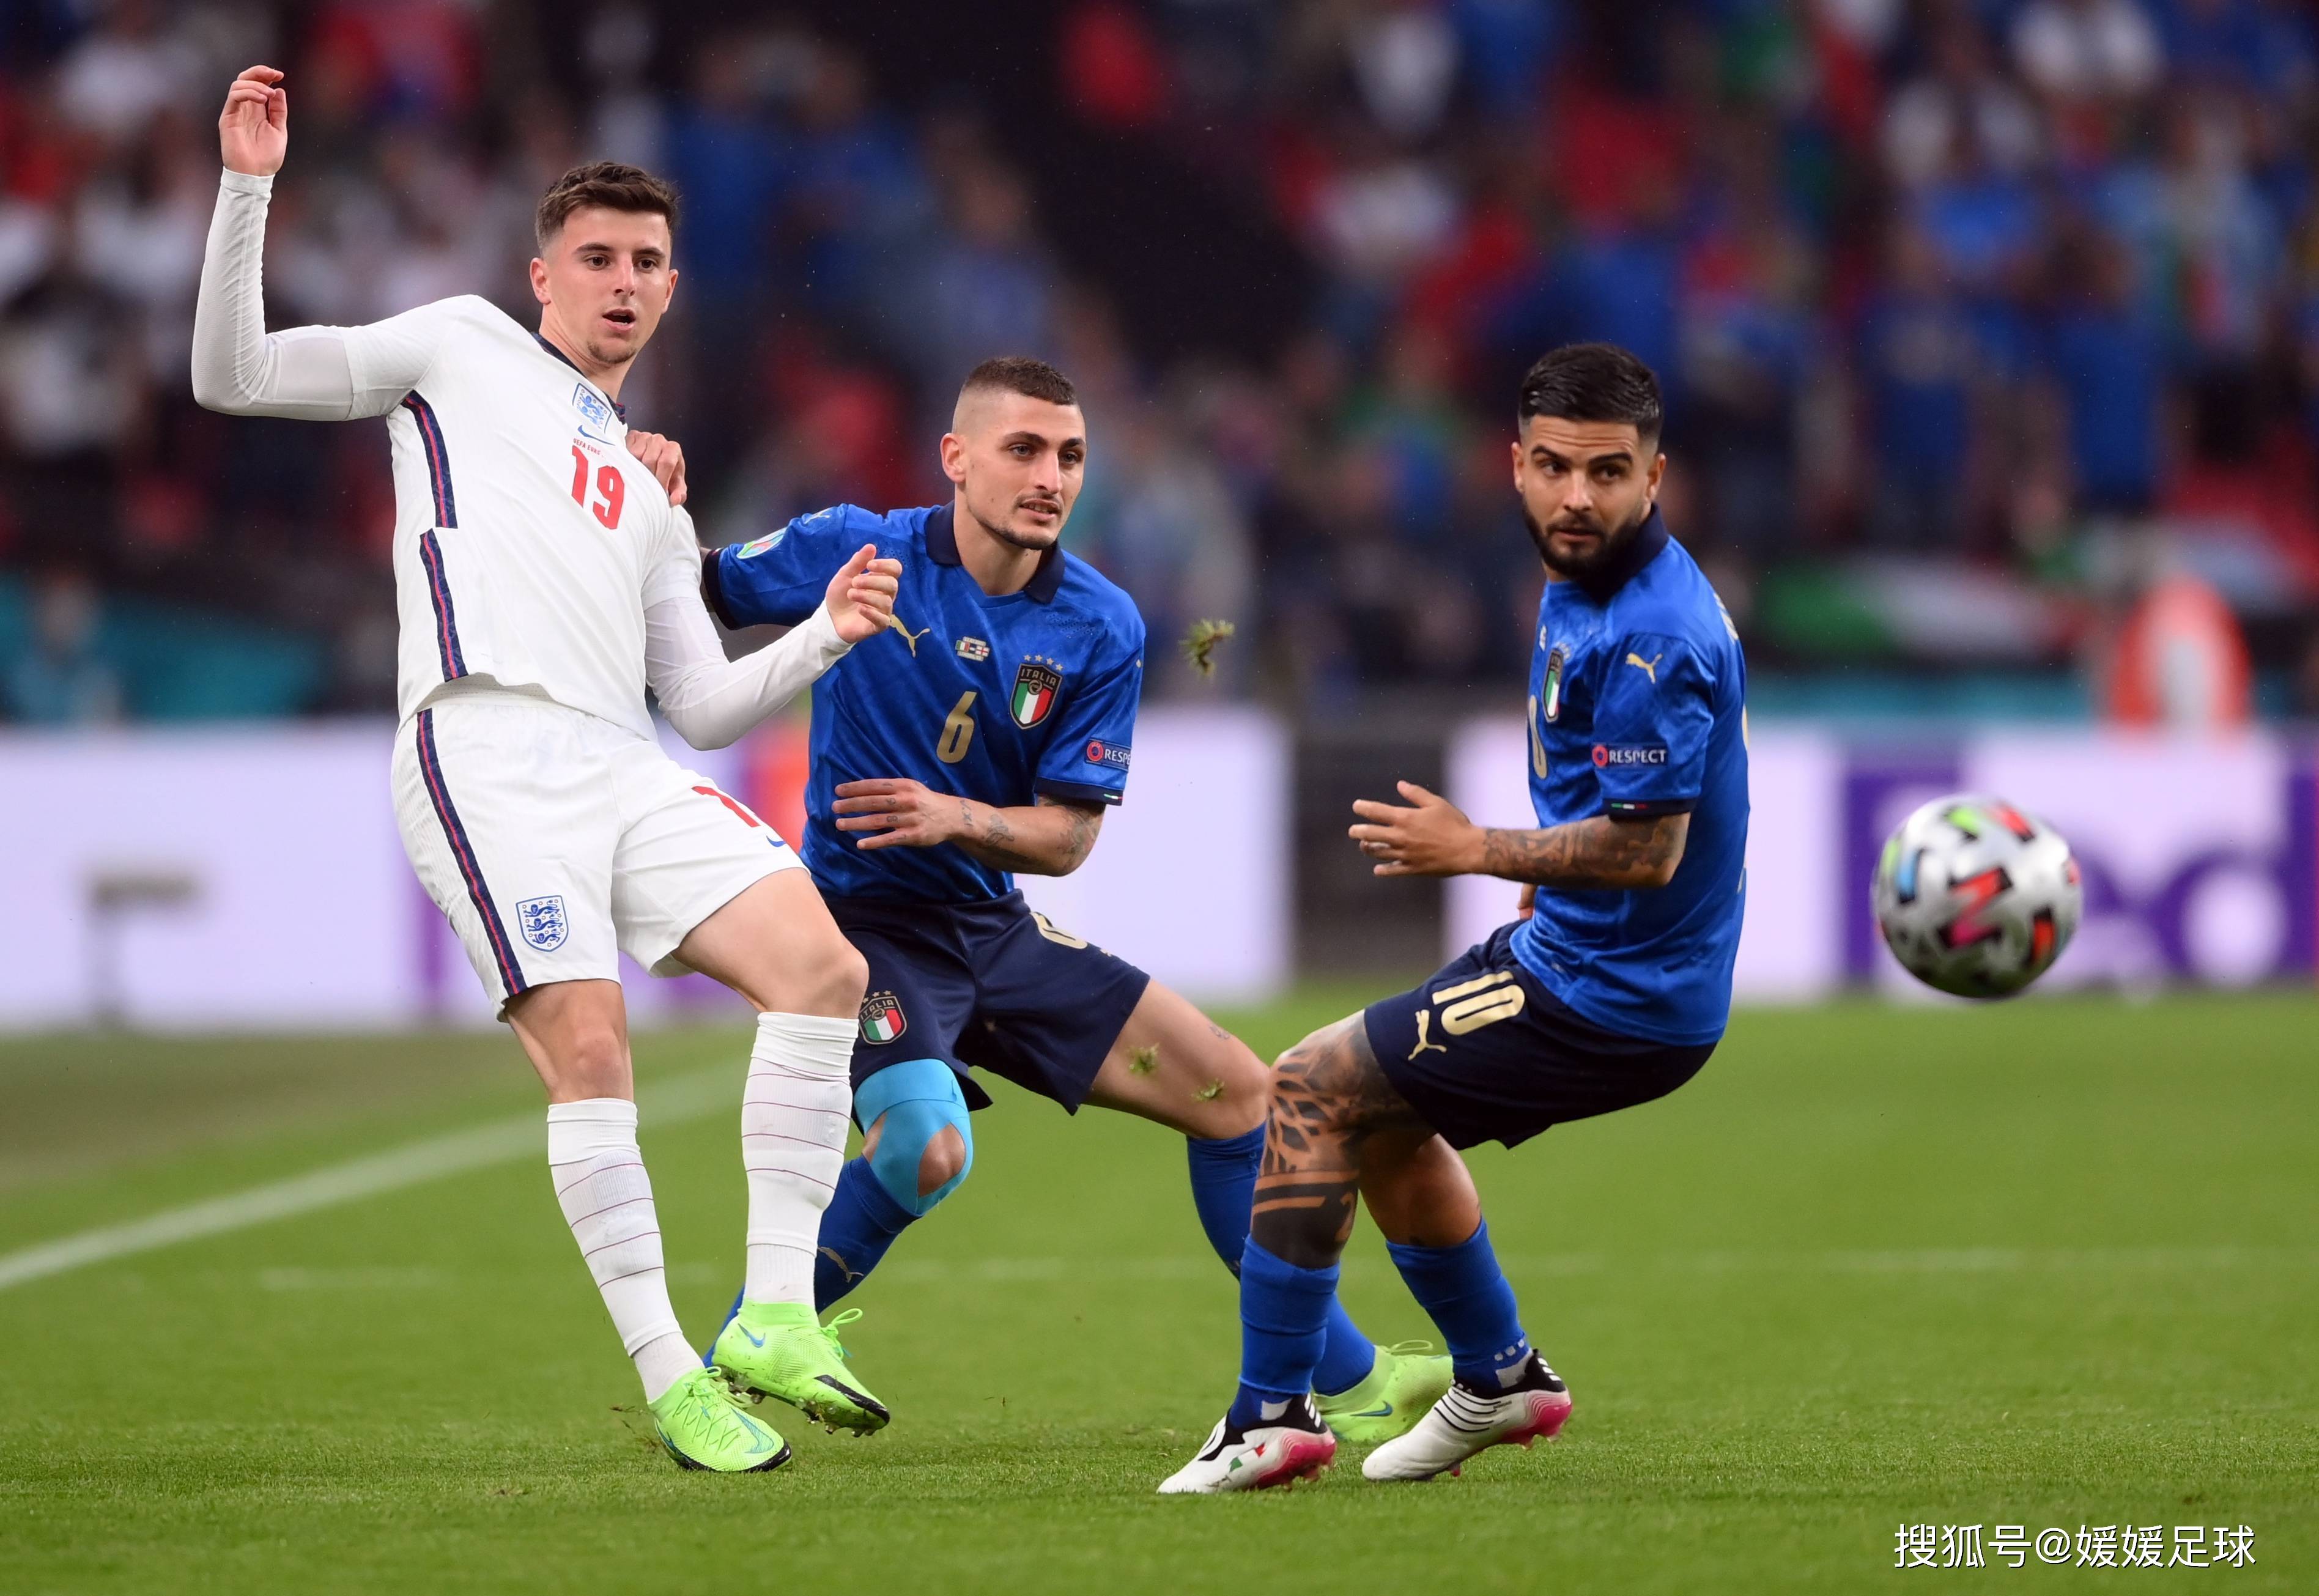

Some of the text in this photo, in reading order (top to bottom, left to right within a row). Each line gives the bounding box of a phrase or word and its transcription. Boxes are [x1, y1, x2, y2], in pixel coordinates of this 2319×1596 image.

[573, 438, 586, 448] UEFA
[571, 445, 625, 530] 19
[1021, 668, 1057, 687] ITALIA
[936, 691, 977, 764] 6
[1609, 748, 1667, 764] RESPECT
[860, 999, 894, 1020] ITALIA
[1432, 970, 1525, 1036] 10
